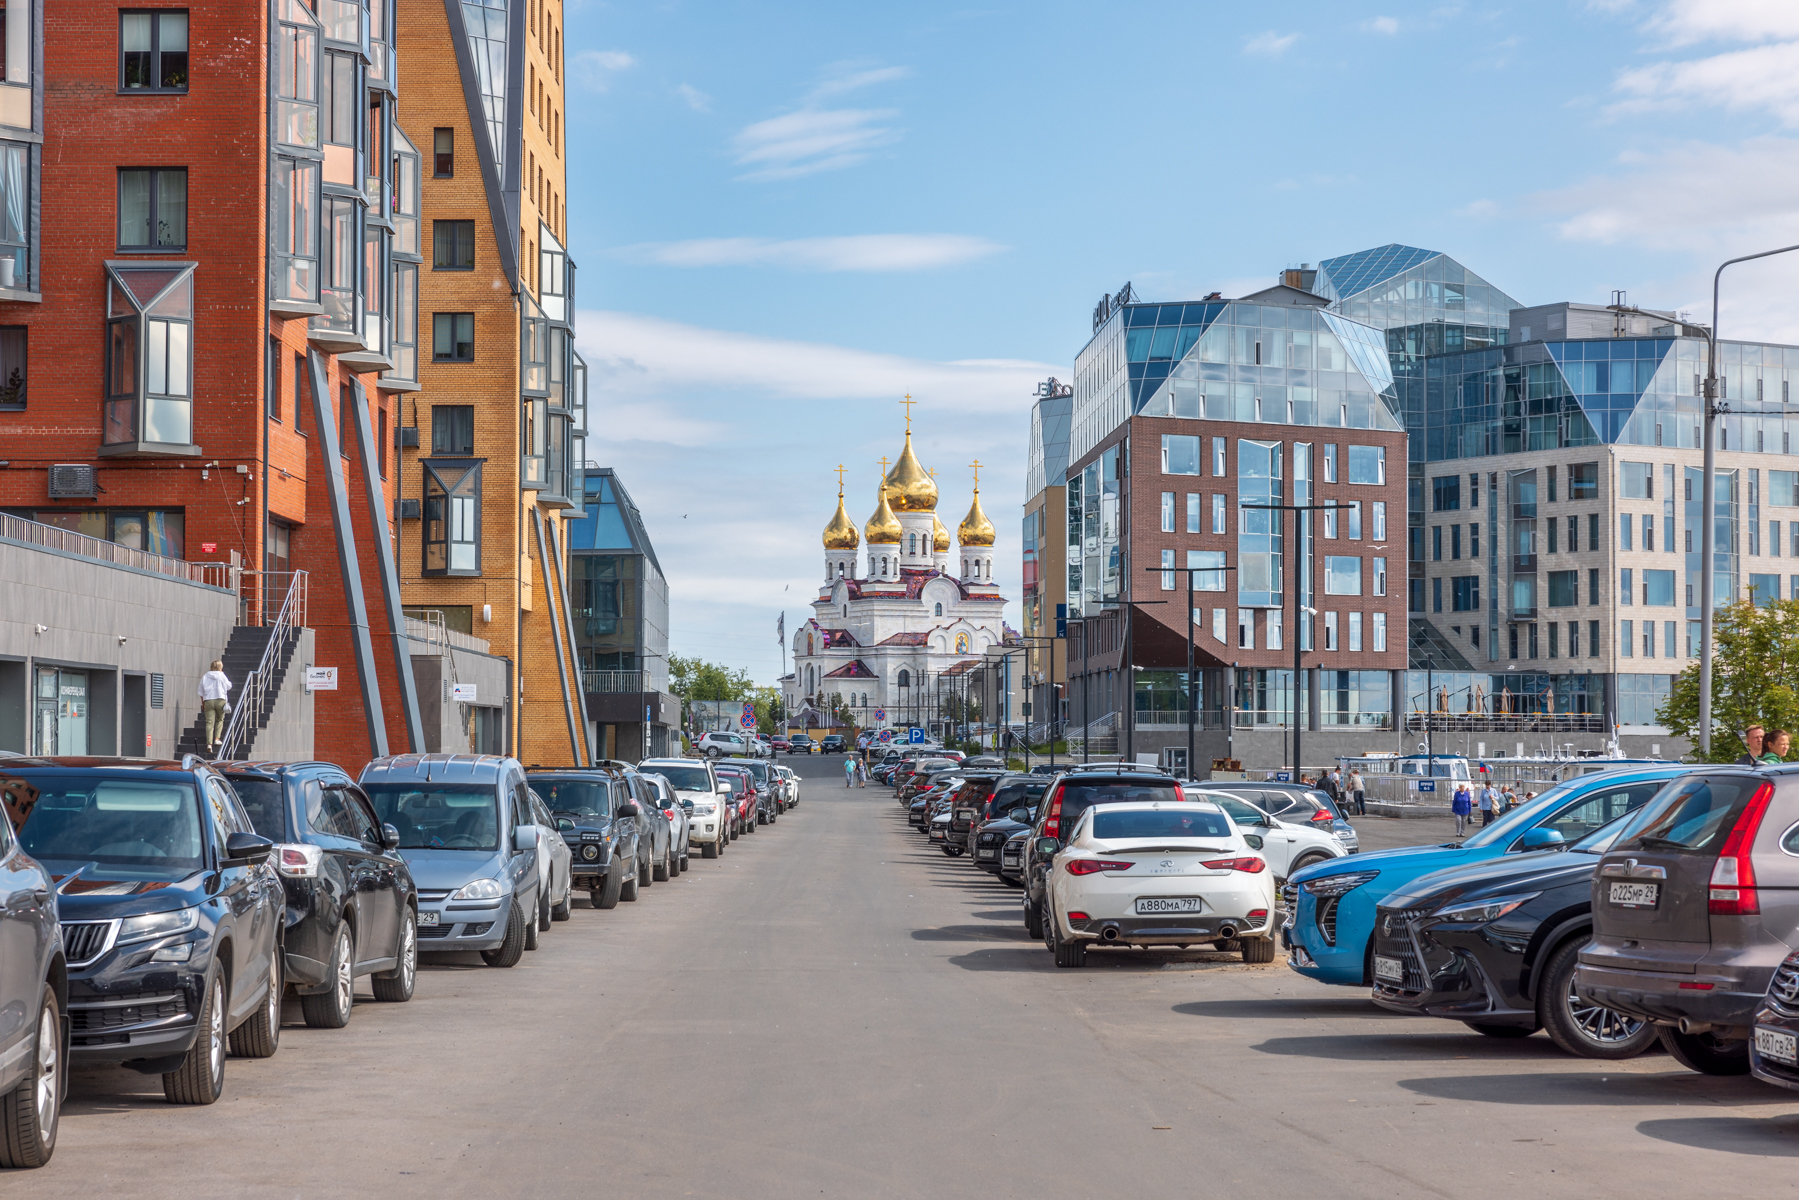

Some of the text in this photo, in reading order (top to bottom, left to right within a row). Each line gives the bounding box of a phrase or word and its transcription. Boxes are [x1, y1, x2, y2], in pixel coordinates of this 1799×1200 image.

[913, 730, 921, 742] P
[1645, 886, 1654, 898] 29
[1140, 899, 1197, 911] А880МА 797
[424, 913, 434, 921] 29
[1758, 1032, 1793, 1054] К887СВ 29
